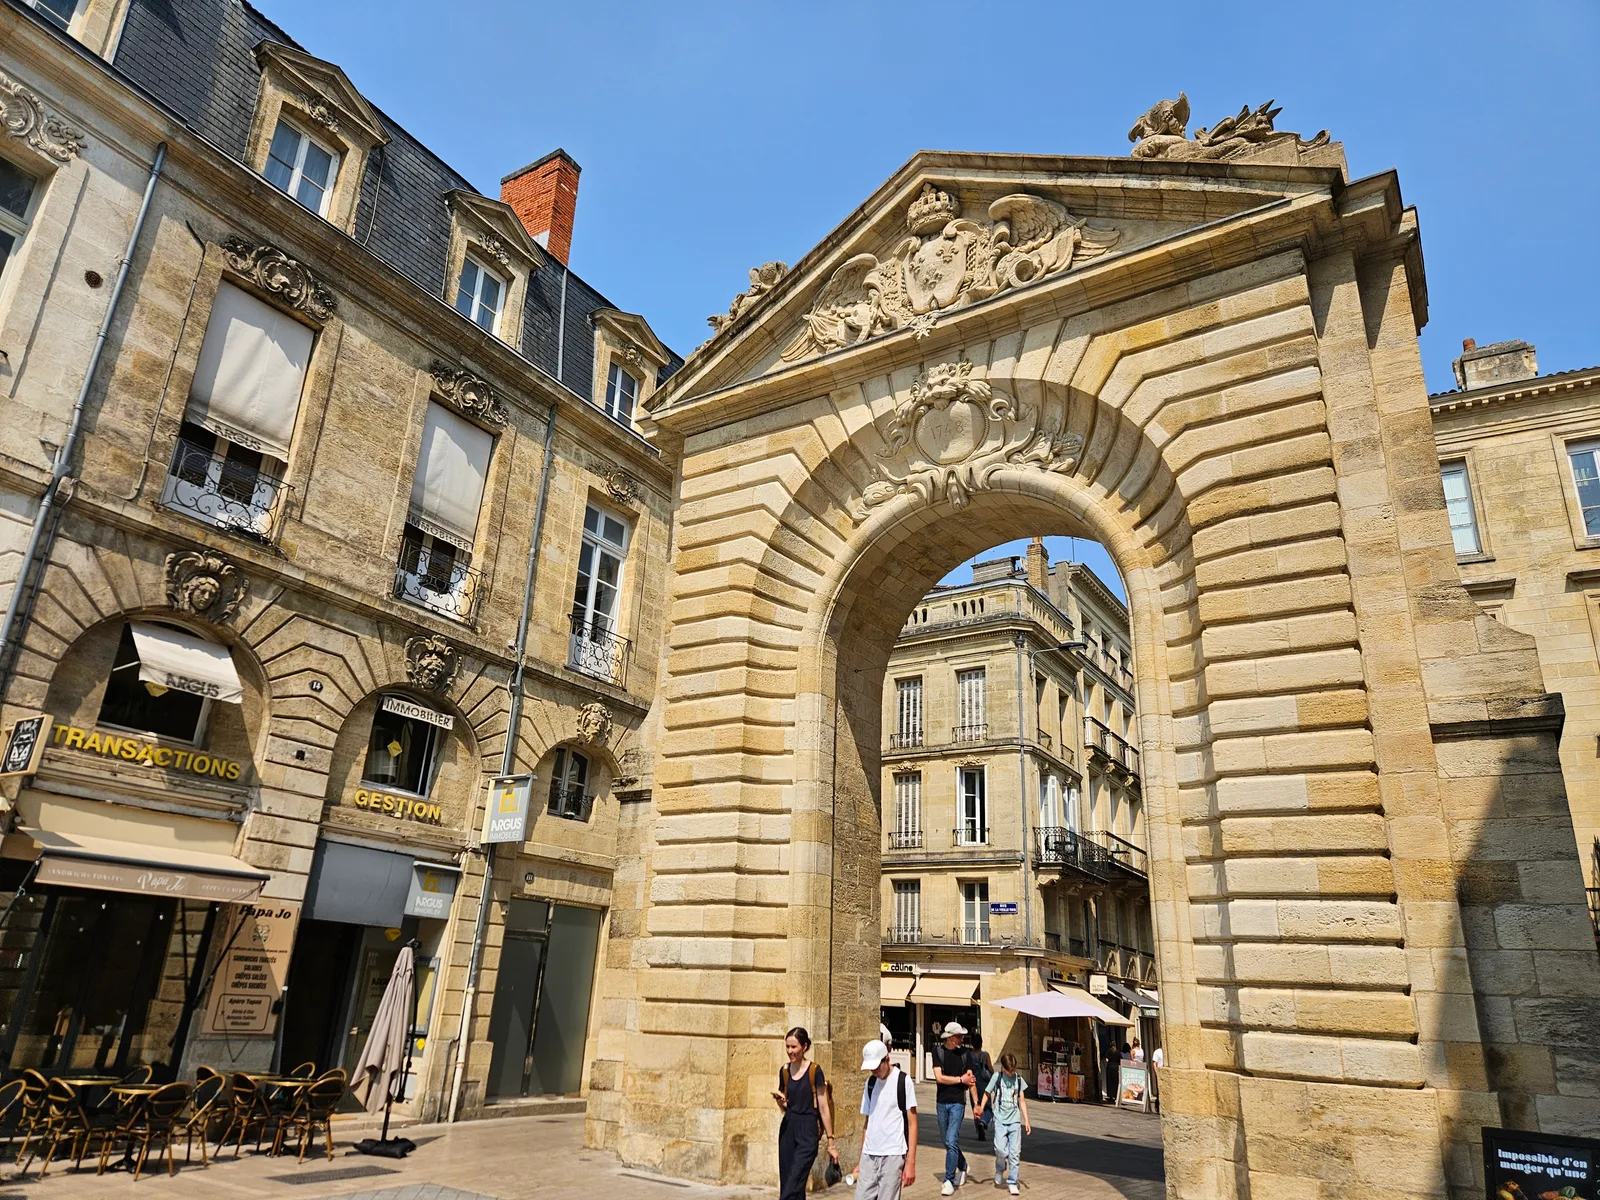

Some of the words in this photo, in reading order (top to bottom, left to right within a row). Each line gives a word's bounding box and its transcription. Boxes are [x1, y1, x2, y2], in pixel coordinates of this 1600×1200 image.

[931, 420, 963, 440] 1748
[165, 672, 220, 698] ARGUS
[312, 681, 321, 690] 14
[385, 699, 451, 728] IMMOBILIER
[52, 724, 240, 779] TRANSACTIONS
[354, 789, 441, 820] GESTION
[491, 817, 522, 832] ARGUS
[489, 831, 520, 840] IMMOBILIER
[137, 872, 169, 890] Papa
[415, 896, 443, 909] ARGUS
[275, 909, 291, 919] Jo
[891, 963, 913, 972] câline
[1497, 1149, 1559, 1165] Impossible
[1561, 1157, 1587, 1169] d'en
[1500, 1160, 1544, 1175] manger
[1546, 1166, 1587, 1179] qu'une
